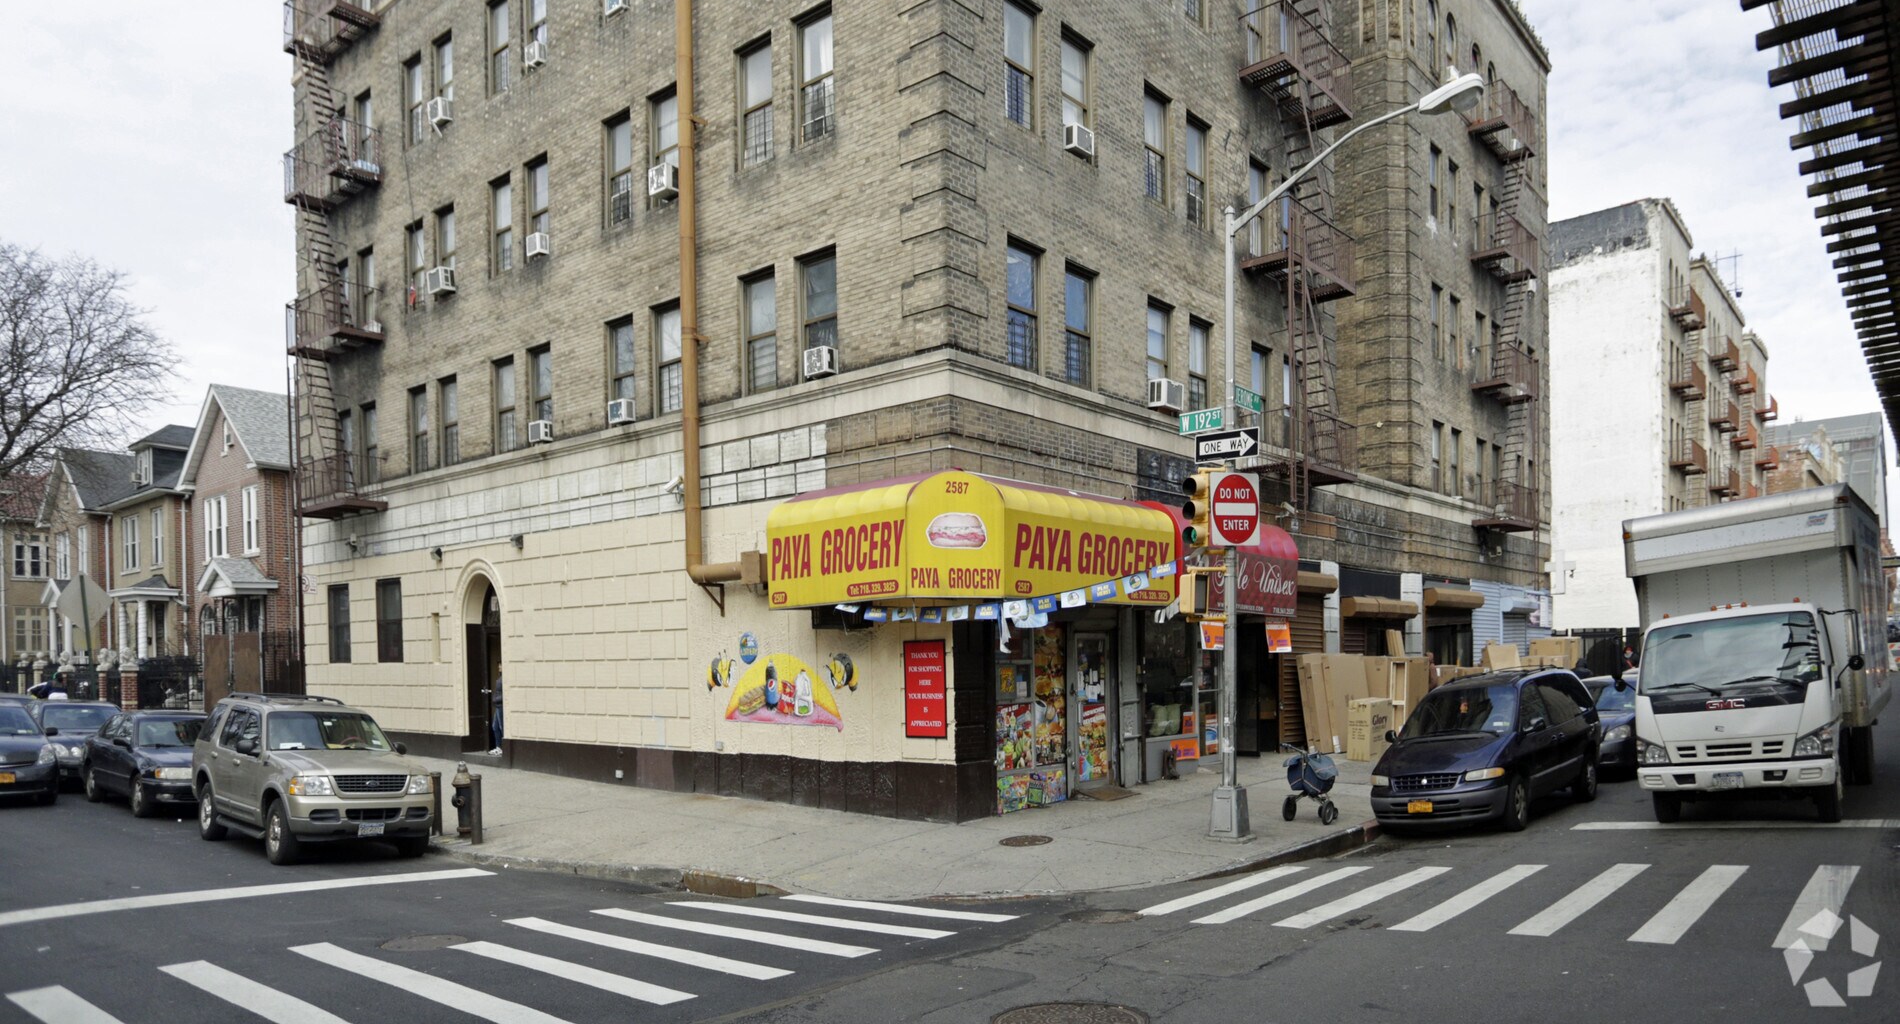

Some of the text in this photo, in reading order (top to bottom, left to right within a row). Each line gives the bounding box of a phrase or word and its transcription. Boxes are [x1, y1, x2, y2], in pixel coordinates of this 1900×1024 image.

[1235, 387, 1254, 409] JEROME
[1182, 410, 1220, 431] W 192 ST
[1204, 438, 1248, 454] ONE WAY
[946, 481, 969, 494] 2587
[1220, 488, 1250, 500] DO NOT
[1223, 519, 1249, 530] ENTER
[771, 519, 905, 581] PAYA GROCERY
[1013, 523, 1170, 580] PAYA GROCERY
[911, 568, 1002, 590] PAYA GROCERY
[1018, 582, 1030, 592] 2587
[1253, 561, 1296, 595] Unisex
[1705, 698, 1745, 710] GMC
